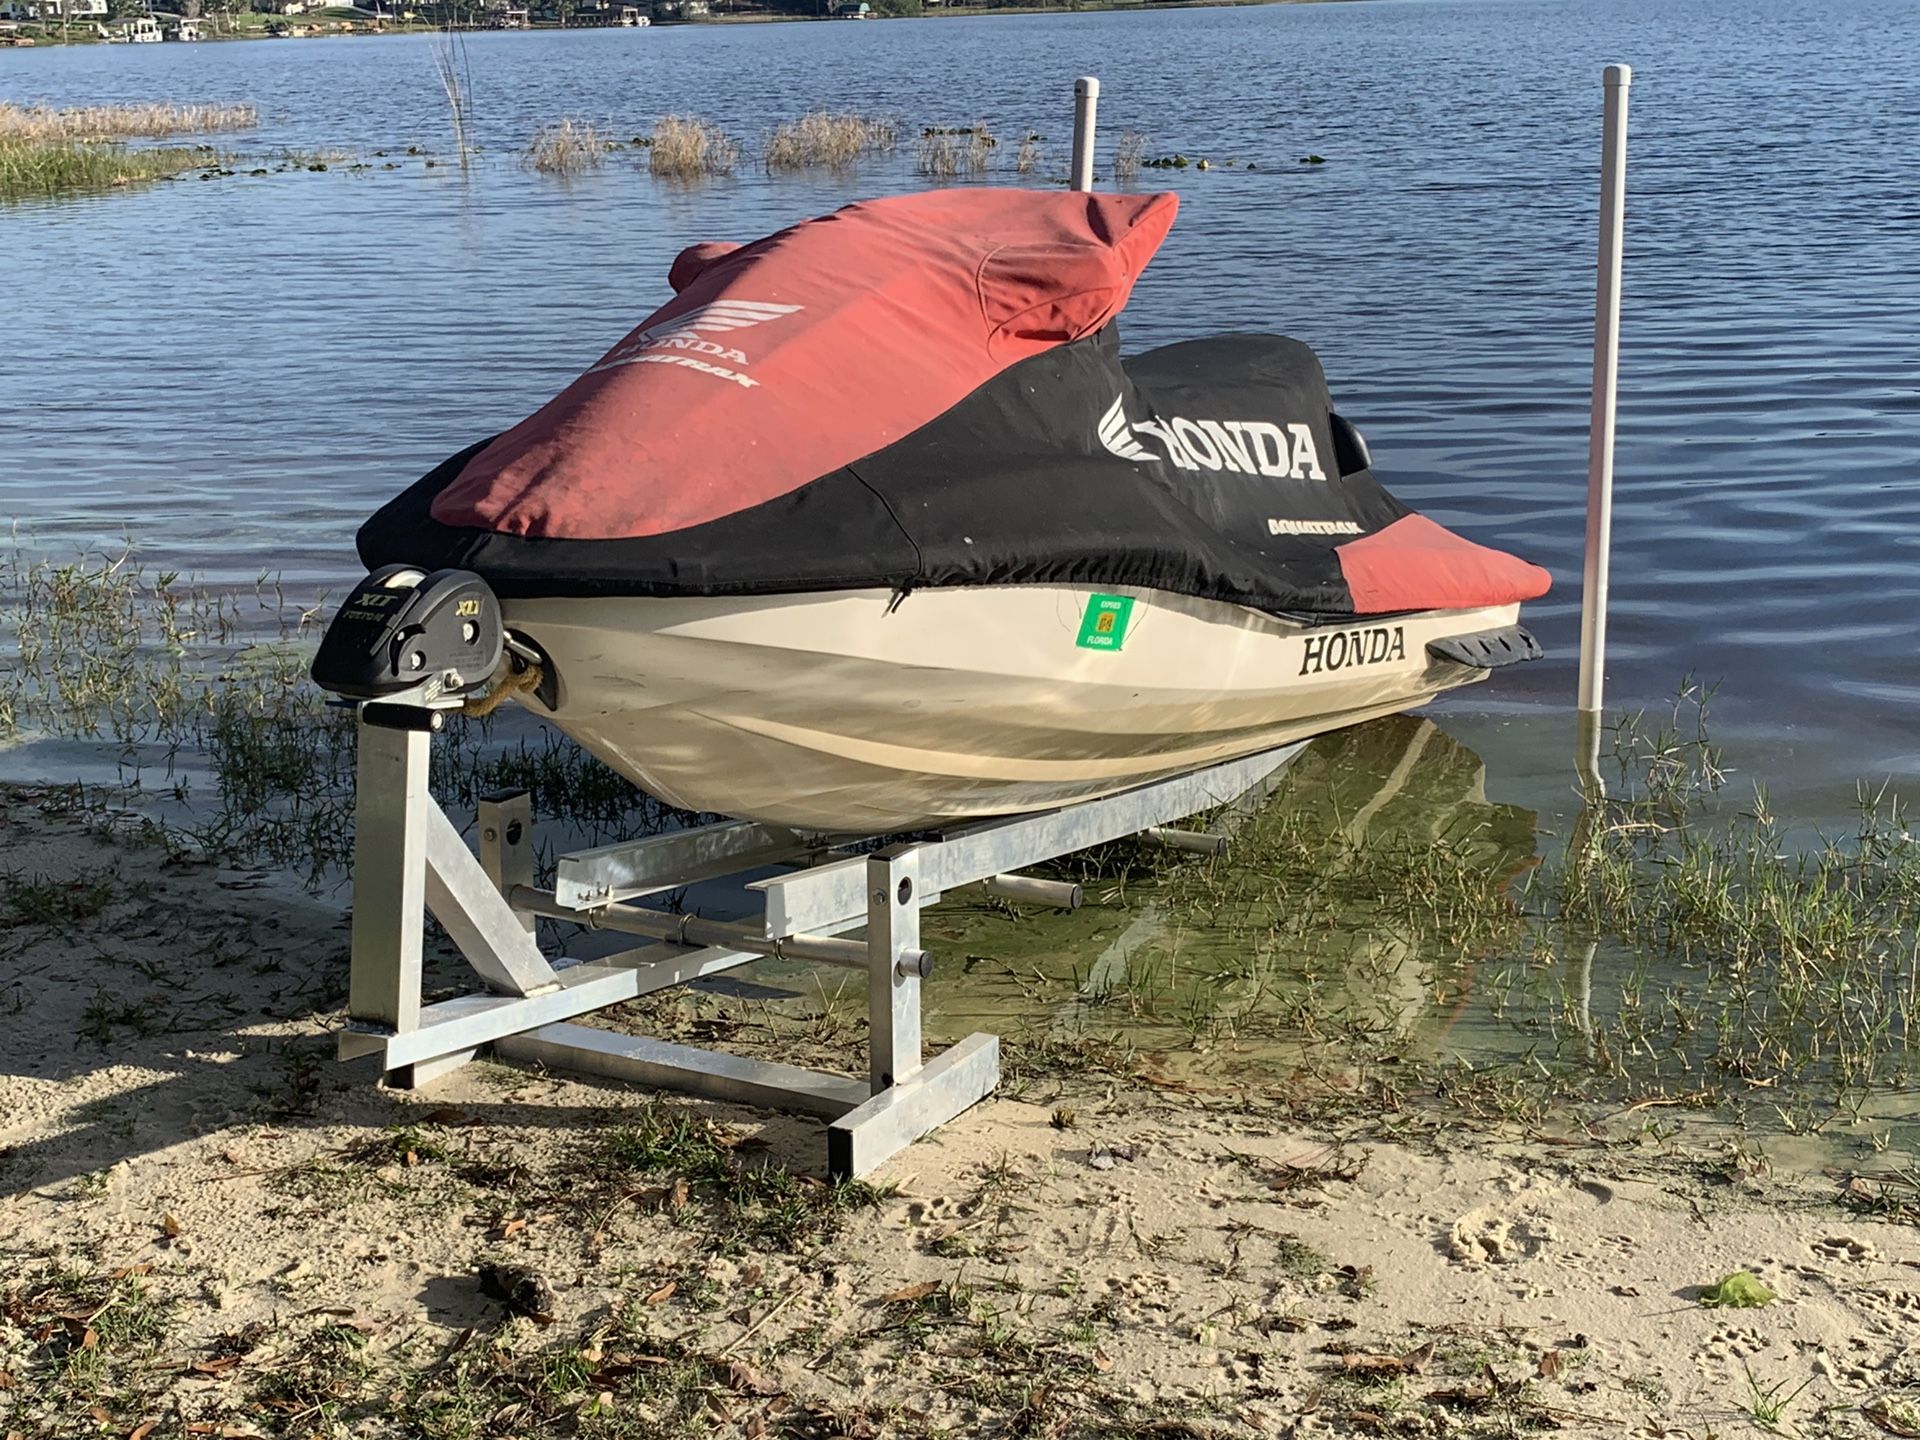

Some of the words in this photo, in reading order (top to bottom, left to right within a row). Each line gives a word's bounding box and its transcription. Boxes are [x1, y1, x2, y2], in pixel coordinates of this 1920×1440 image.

[1131, 415, 1327, 481] HONDA
[1267, 518, 1366, 536] AQUATRAX
[354, 593, 399, 607] XLT
[1087, 635, 1113, 646] FLORIDA
[1298, 626, 1406, 676] HONDA
